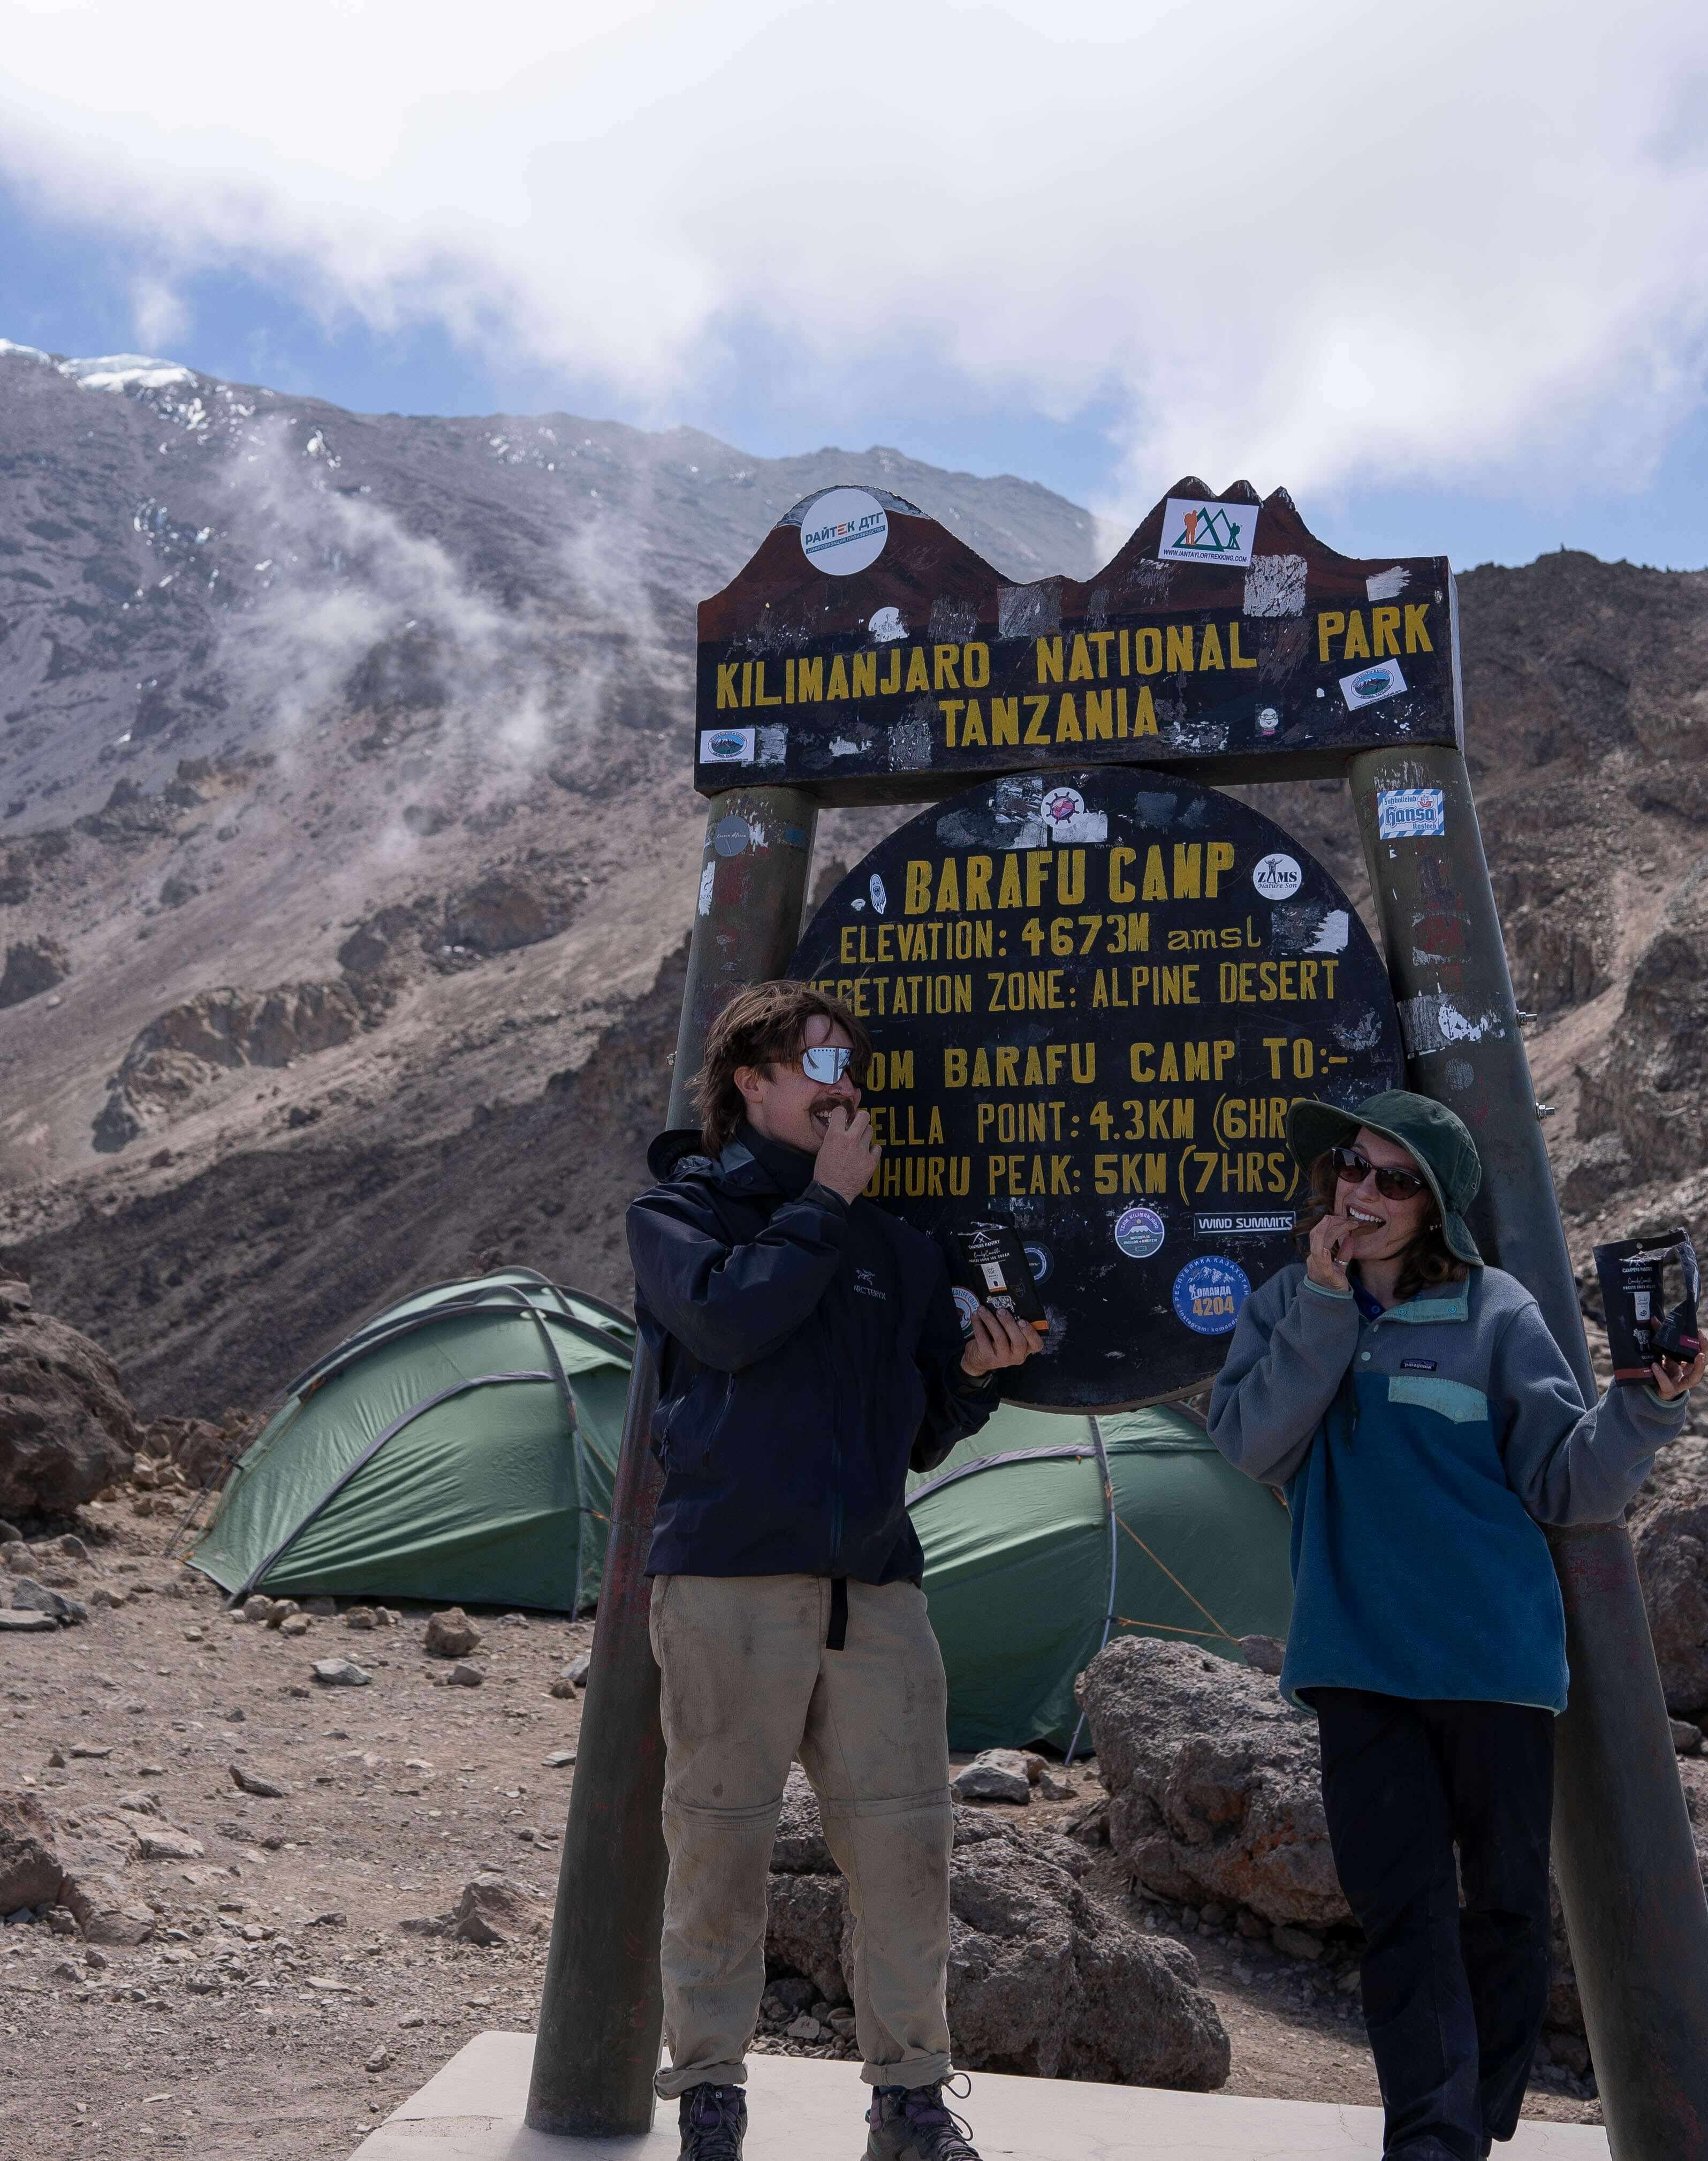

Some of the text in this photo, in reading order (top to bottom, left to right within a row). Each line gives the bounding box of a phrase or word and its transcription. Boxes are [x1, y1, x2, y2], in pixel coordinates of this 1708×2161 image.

[805, 511, 884, 545] РАЙТЕК ДТГ
[807, 526, 884, 553] ЦИФРОВИЗАЦИЯ ПРОИЗВОДСТВА
[1163, 549, 1247, 562] WWW.IANTAYLORTREKKING.COM
[717, 604, 1433, 709] KILIMANJARO NATIONAL PARK
[939, 686, 1159, 747] TANZANIA
[905, 842, 1234, 914] BARAFU CAMP
[841, 920, 1007, 964] ELEVATION:
[1022, 912, 1149, 956] 4673M
[988, 970, 1076, 1011] ZONE:
[1093, 965, 1200, 1007] ALPINE
[1220, 960, 1339, 1003] DESERT
[867, 1050, 914, 1091] OM
[945, 1043, 1096, 1089] BARAFU
[1130, 1040, 1235, 1082] CAMP
[856, 1093, 1320, 1150] ELLA POINT: 4.3KM (6HR
[989, 1155, 1080, 1195] PEAK:
[1095, 1154, 1166, 1194] 5KM
[1179, 1145, 1300, 1205] (7HRS)
[984, 1239, 1000, 1247] PANTRY
[1120, 1212, 1159, 1232] TEAM KILIMANJARO
[1198, 1217, 1293, 1230] WIND SUMMITS
[1174, 1257, 1249, 1301] РЕСПУБЛИКА КАЗАХСТАН
[1179, 1309, 1239, 1332] Instagram: komanda
[1193, 1295, 1234, 1317] 4204
